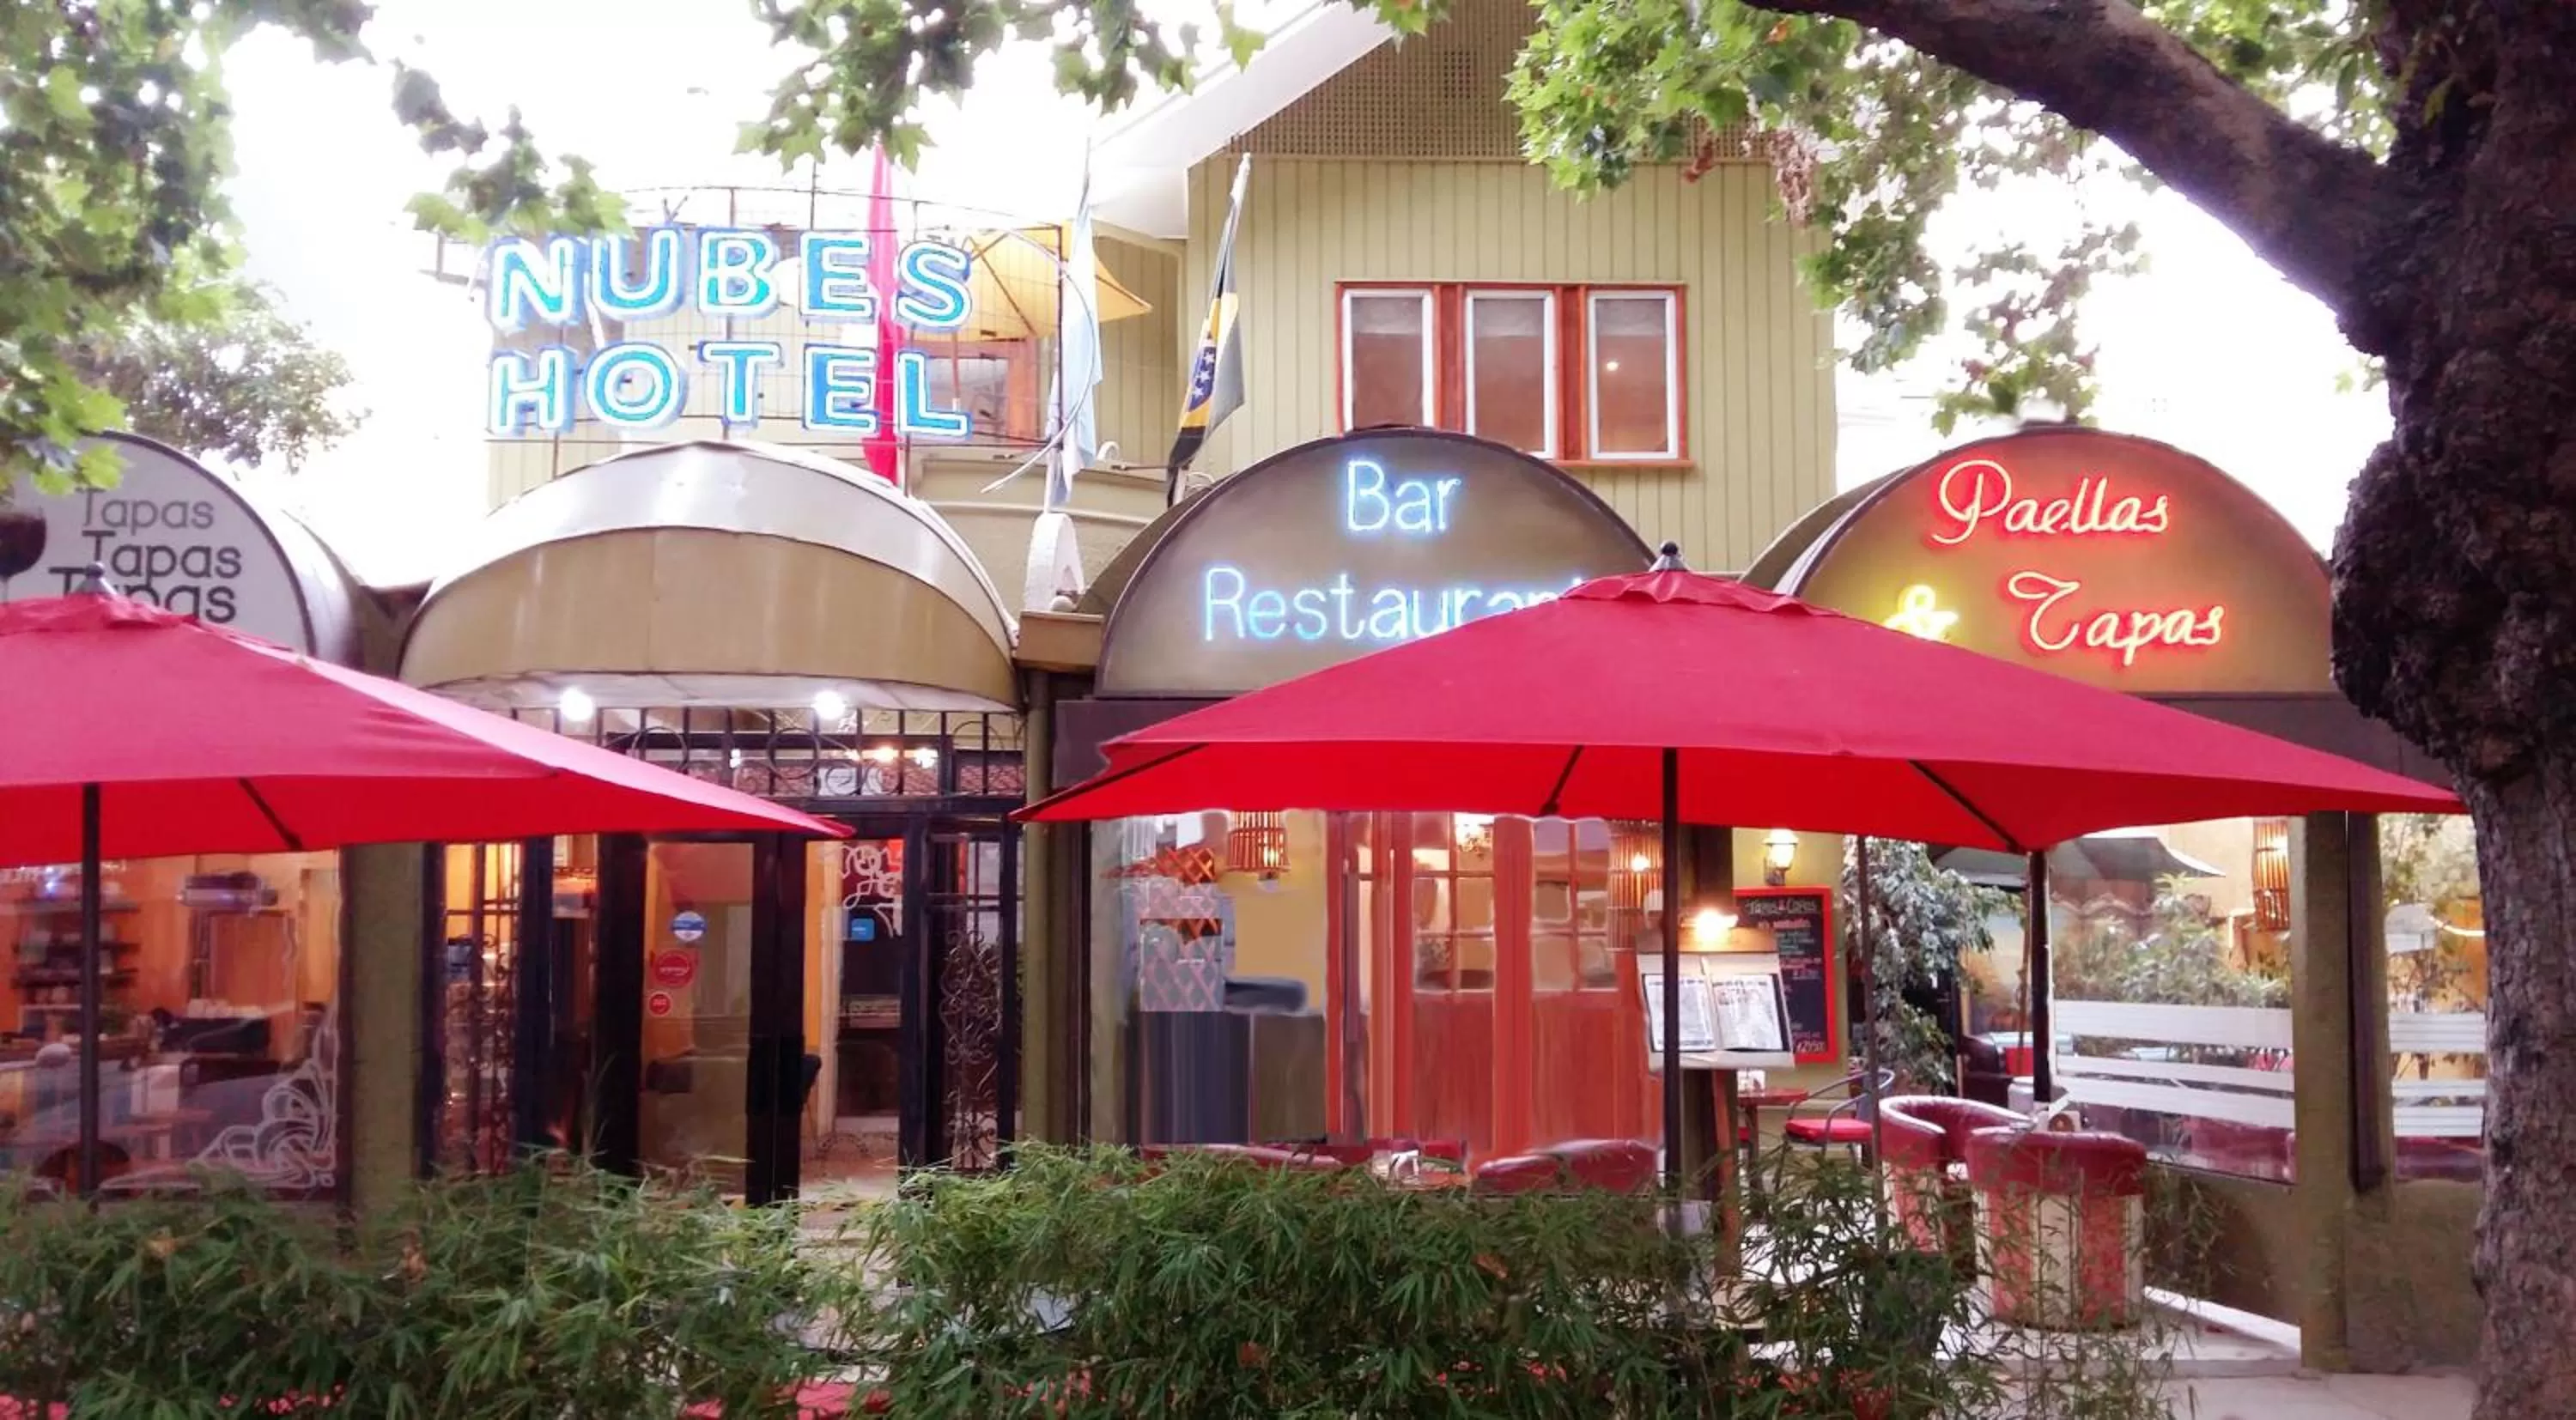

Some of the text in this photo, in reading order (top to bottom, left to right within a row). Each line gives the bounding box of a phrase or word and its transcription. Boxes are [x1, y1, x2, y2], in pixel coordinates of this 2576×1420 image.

[487, 224, 974, 331] NUBES
[490, 341, 972, 439] HOTEL
[76, 487, 214, 537] Tapas
[1346, 459, 1461, 532] Bar
[1932, 458, 2169, 544] Paellas
[82, 530, 242, 586] Tapas
[1204, 566, 1584, 641] Restaur
[2008, 570, 2226, 666] Tapas
